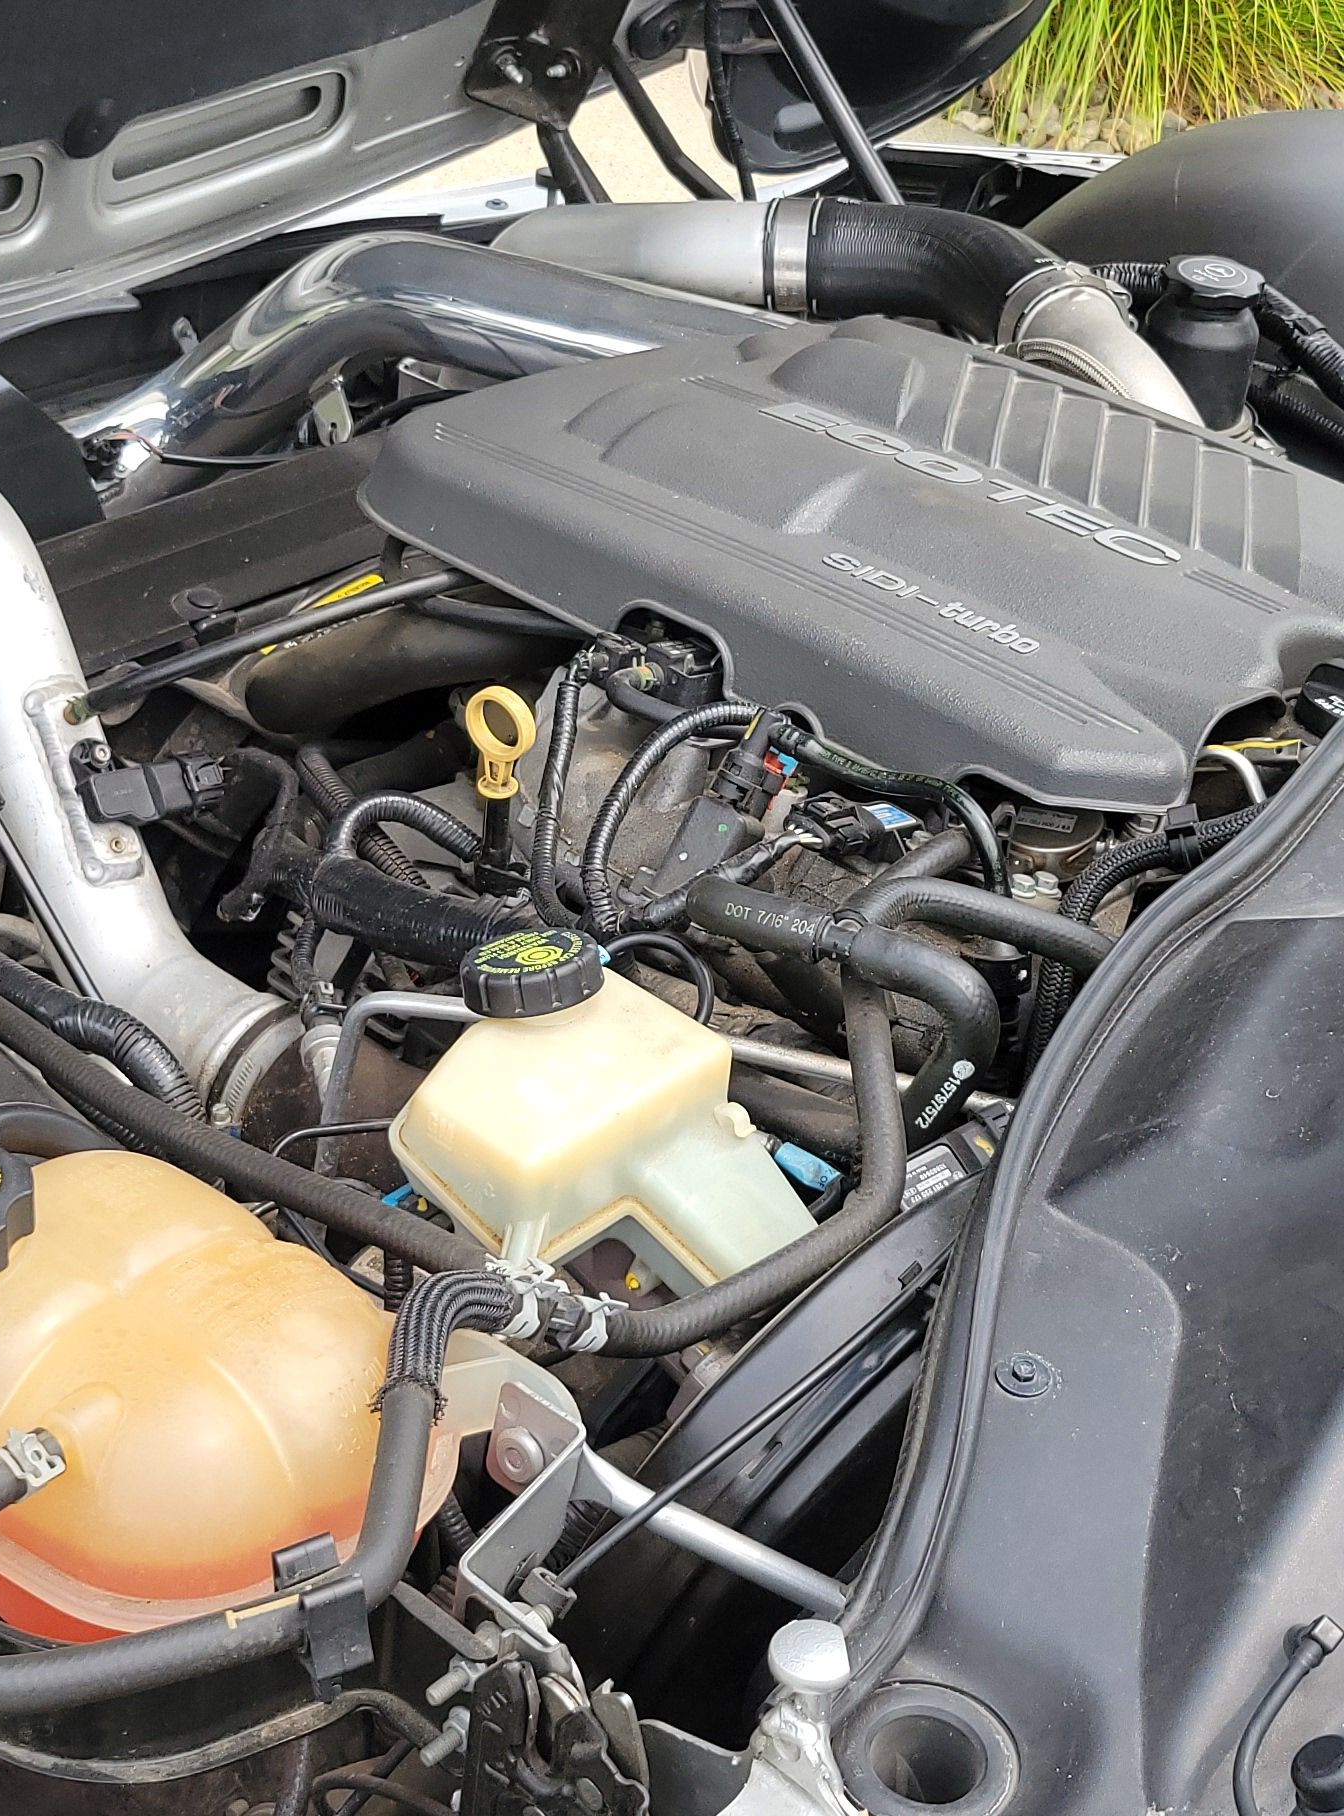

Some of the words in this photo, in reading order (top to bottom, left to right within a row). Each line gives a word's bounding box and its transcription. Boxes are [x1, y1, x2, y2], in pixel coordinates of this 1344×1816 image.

[758, 402, 1181, 565] ECOTEC
[725, 903, 752, 920] DOT
[915, 1076, 961, 1128] 15797572
